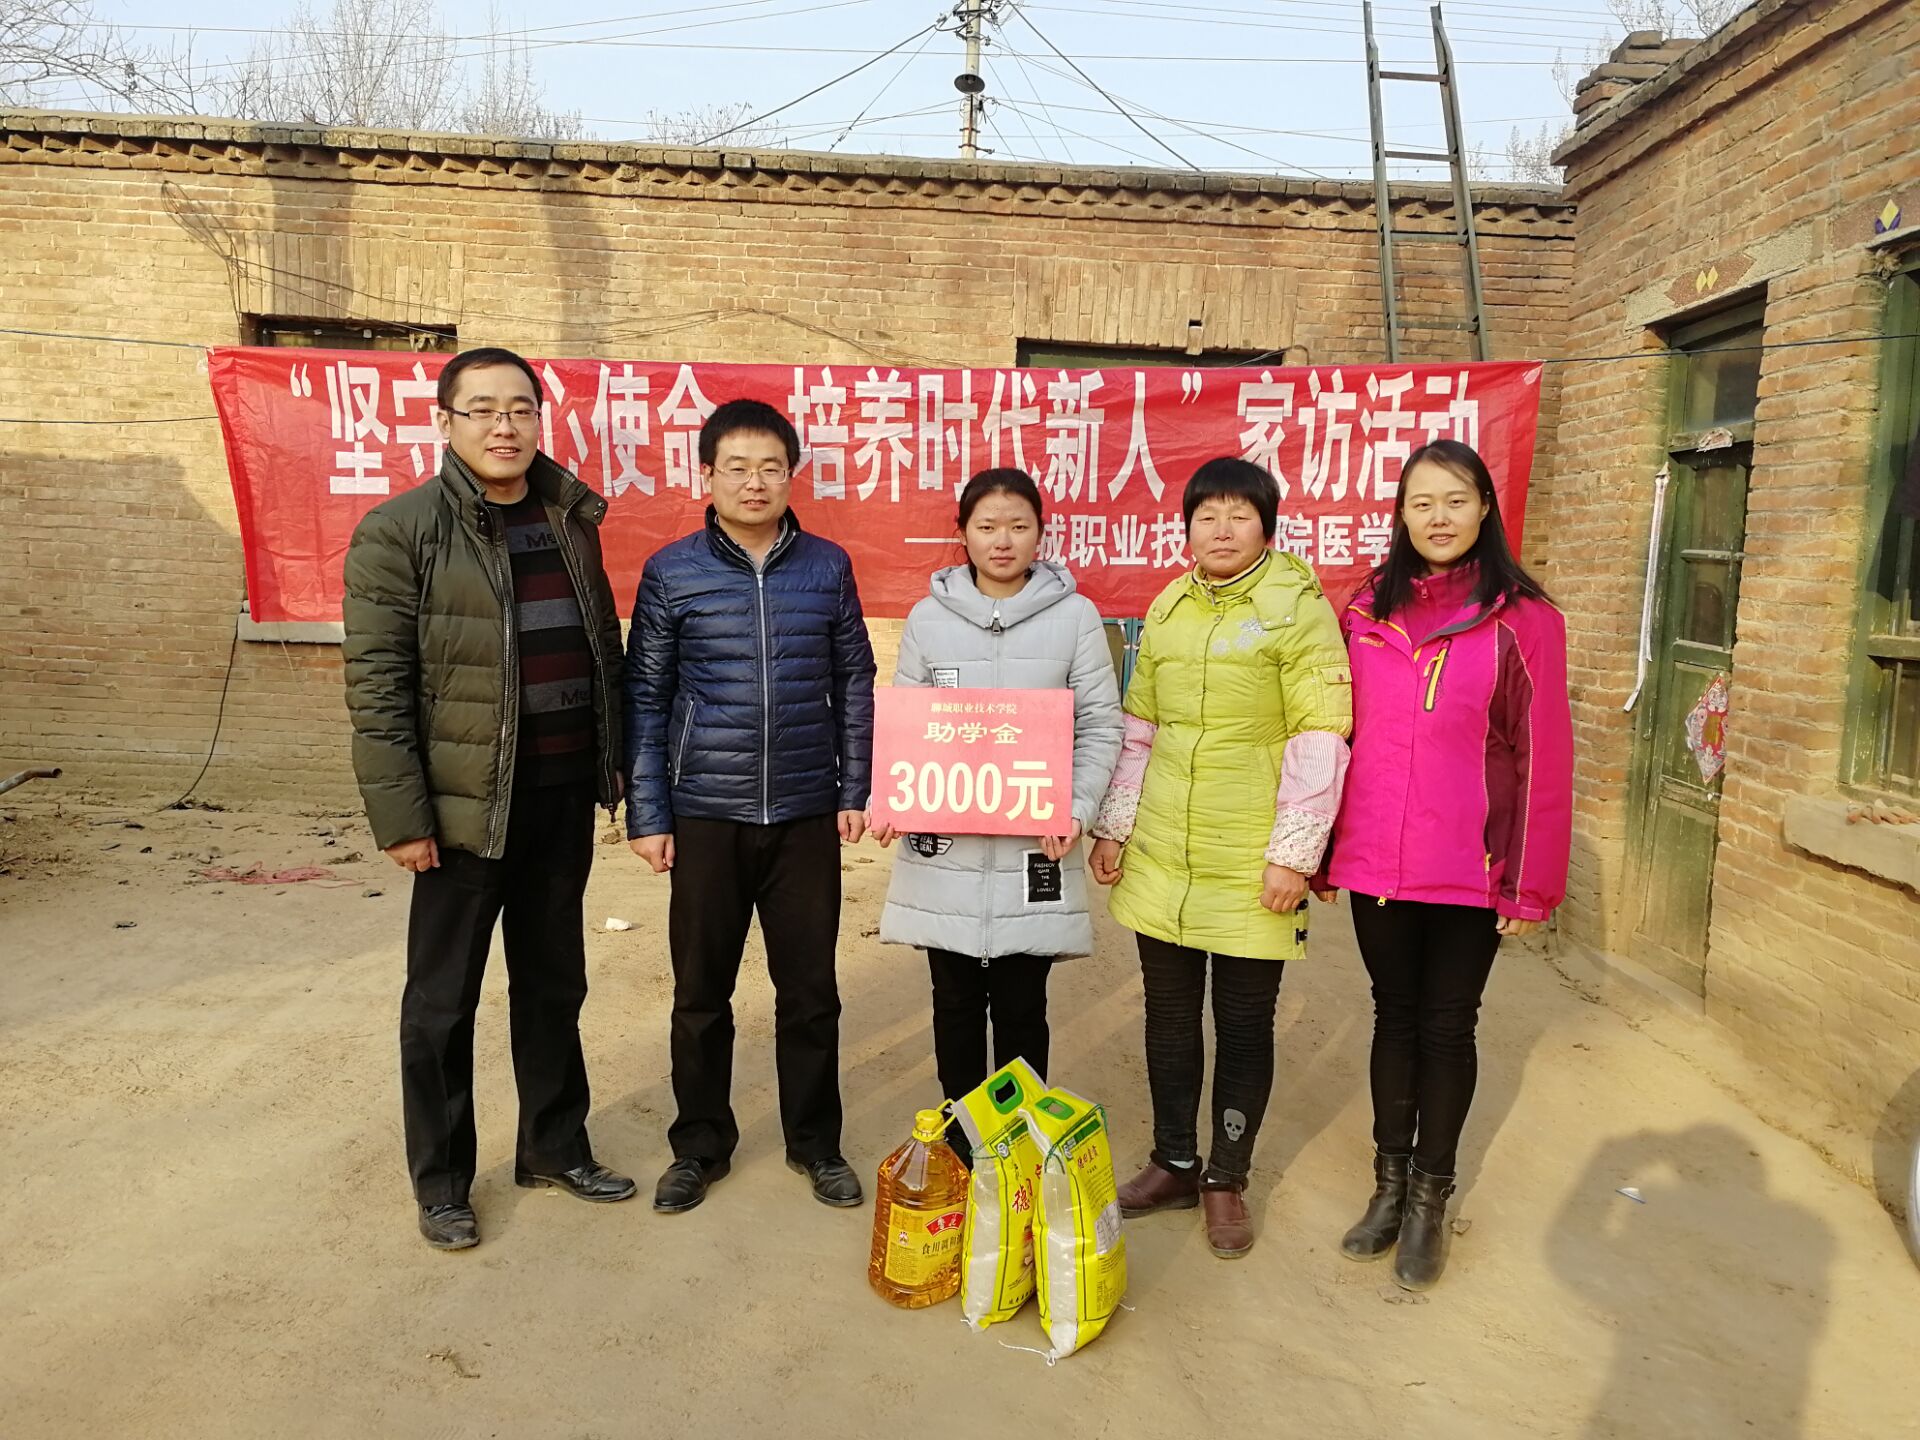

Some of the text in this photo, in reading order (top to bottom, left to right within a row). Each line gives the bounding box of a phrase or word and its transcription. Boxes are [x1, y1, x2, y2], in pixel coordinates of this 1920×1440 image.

[923, 722, 1023, 744] 助学金
[887, 760, 1055, 821] 3000元
